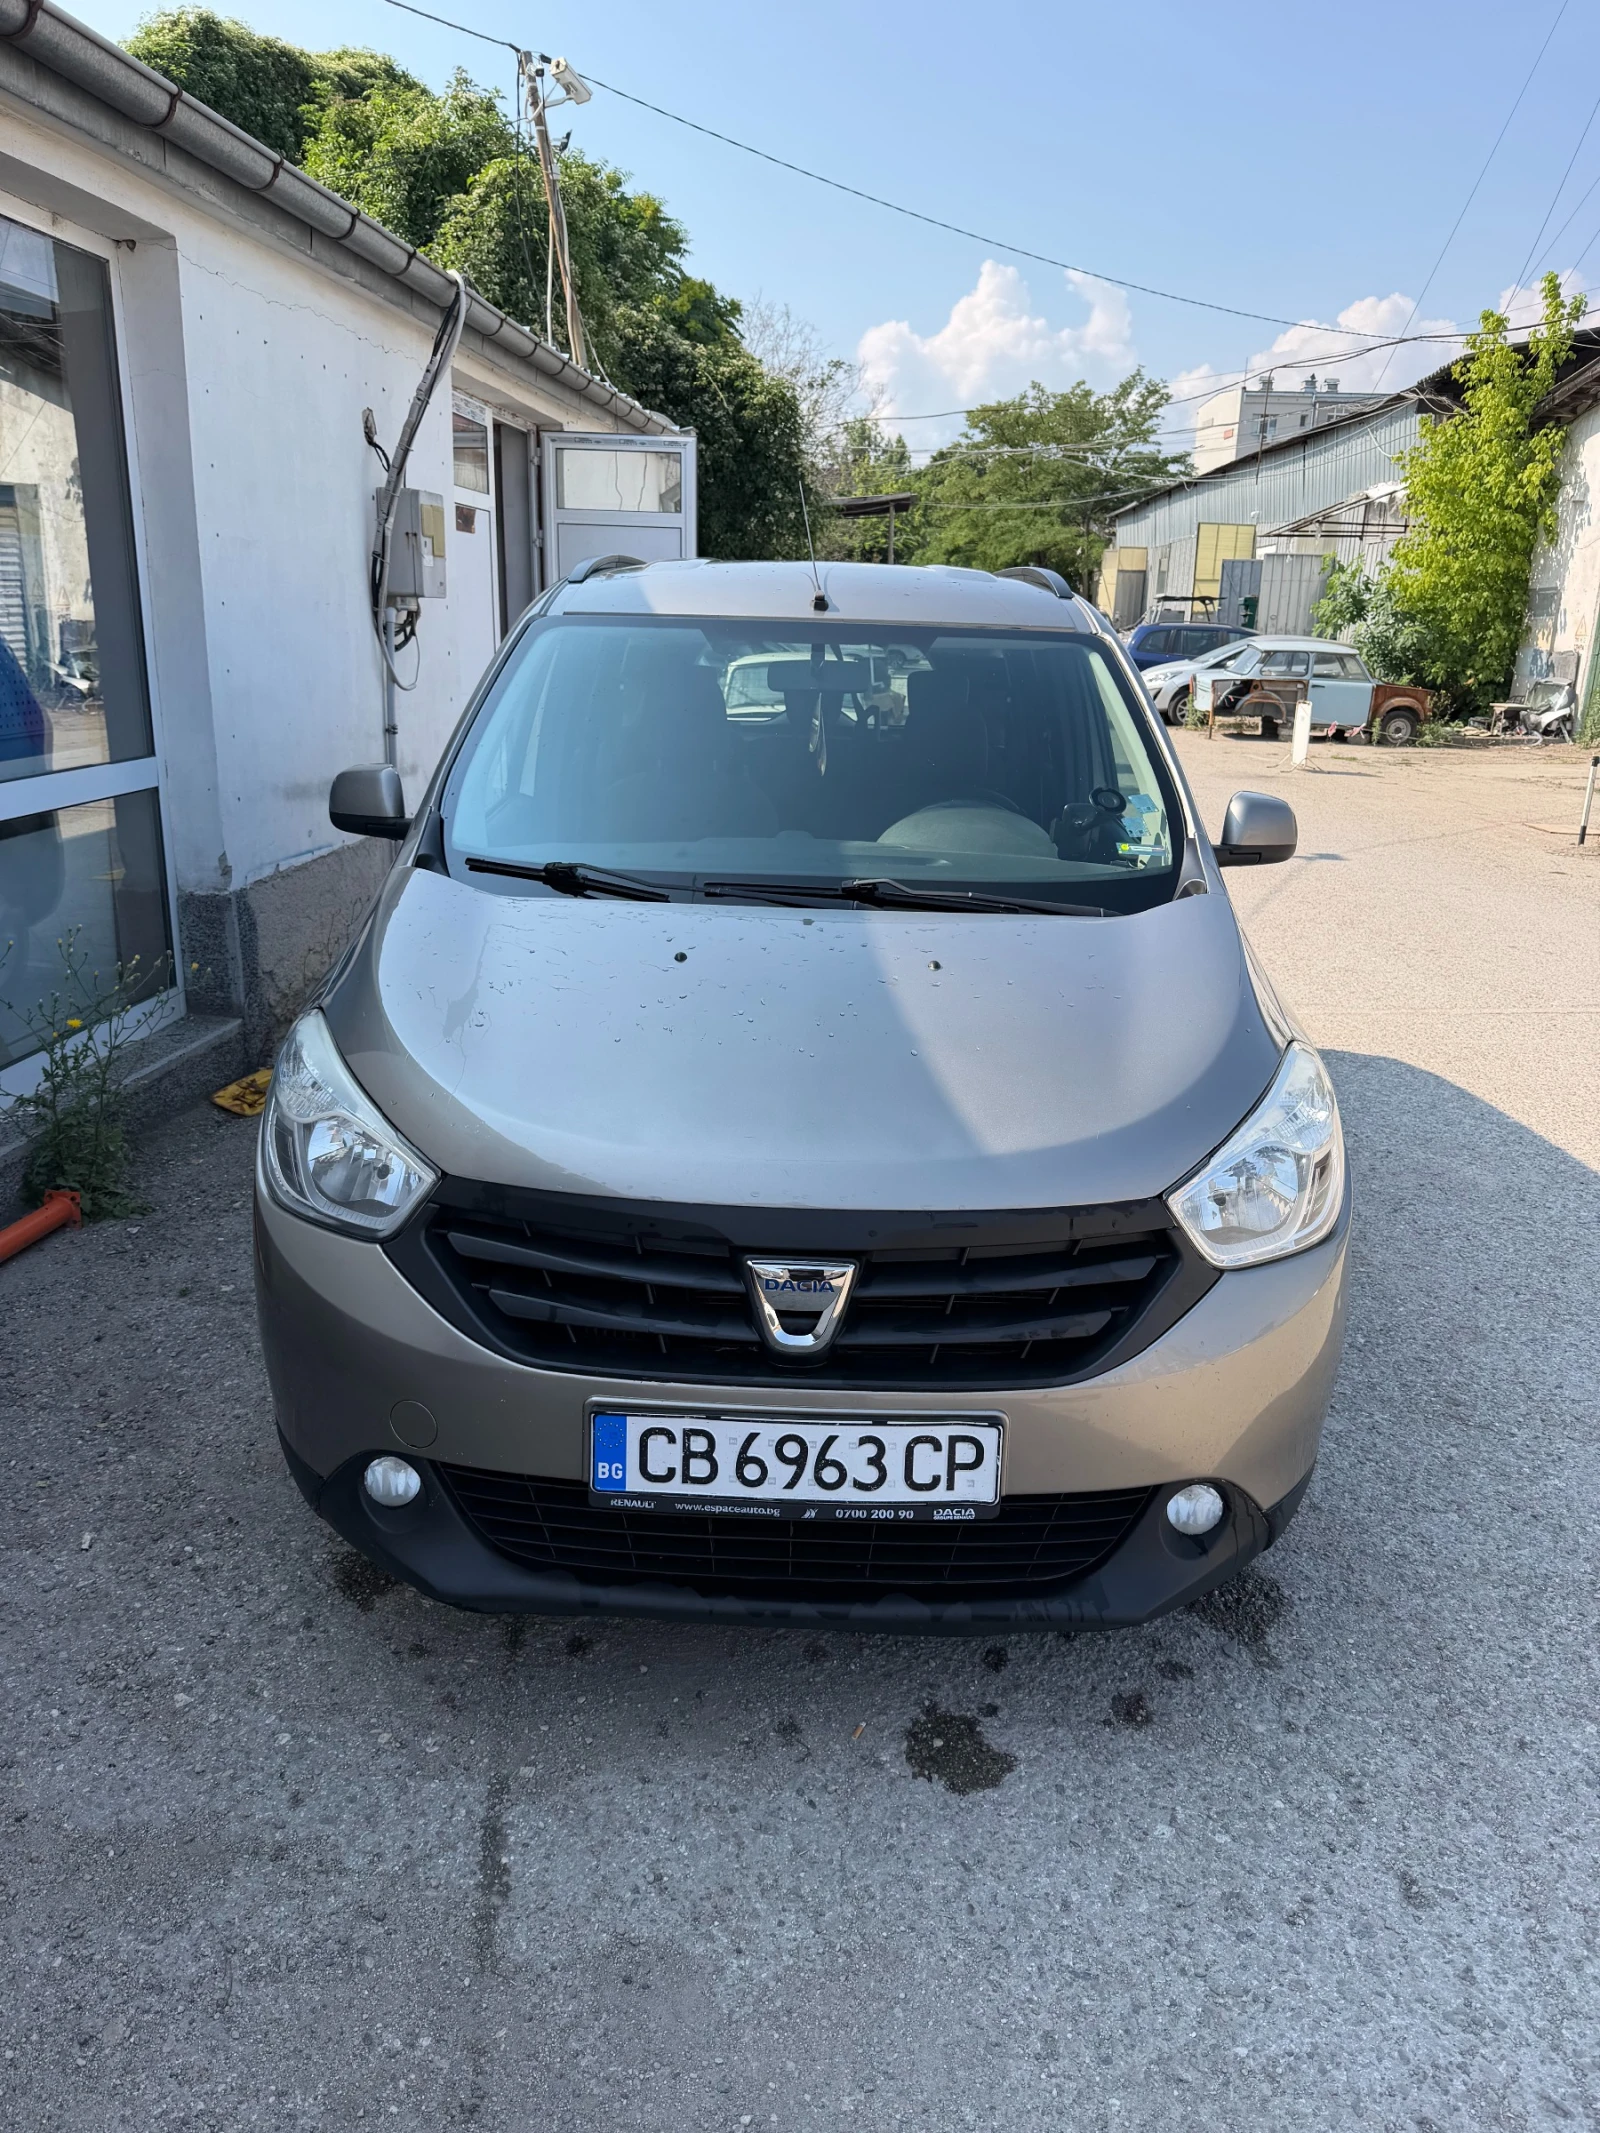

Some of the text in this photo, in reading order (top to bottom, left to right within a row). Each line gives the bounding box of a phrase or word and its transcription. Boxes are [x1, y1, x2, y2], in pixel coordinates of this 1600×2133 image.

[764, 1279, 835, 1293] DACIA
[638, 1426, 985, 1492] CB 6963 CP
[597, 1461, 623, 1480] BG
[610, 1498, 656, 1509] RENAULT
[675, 1502, 781, 1517] www.espaceauto.bg
[835, 1509, 914, 1520] 0700 200 90
[933, 1508, 976, 1516] DACIA
